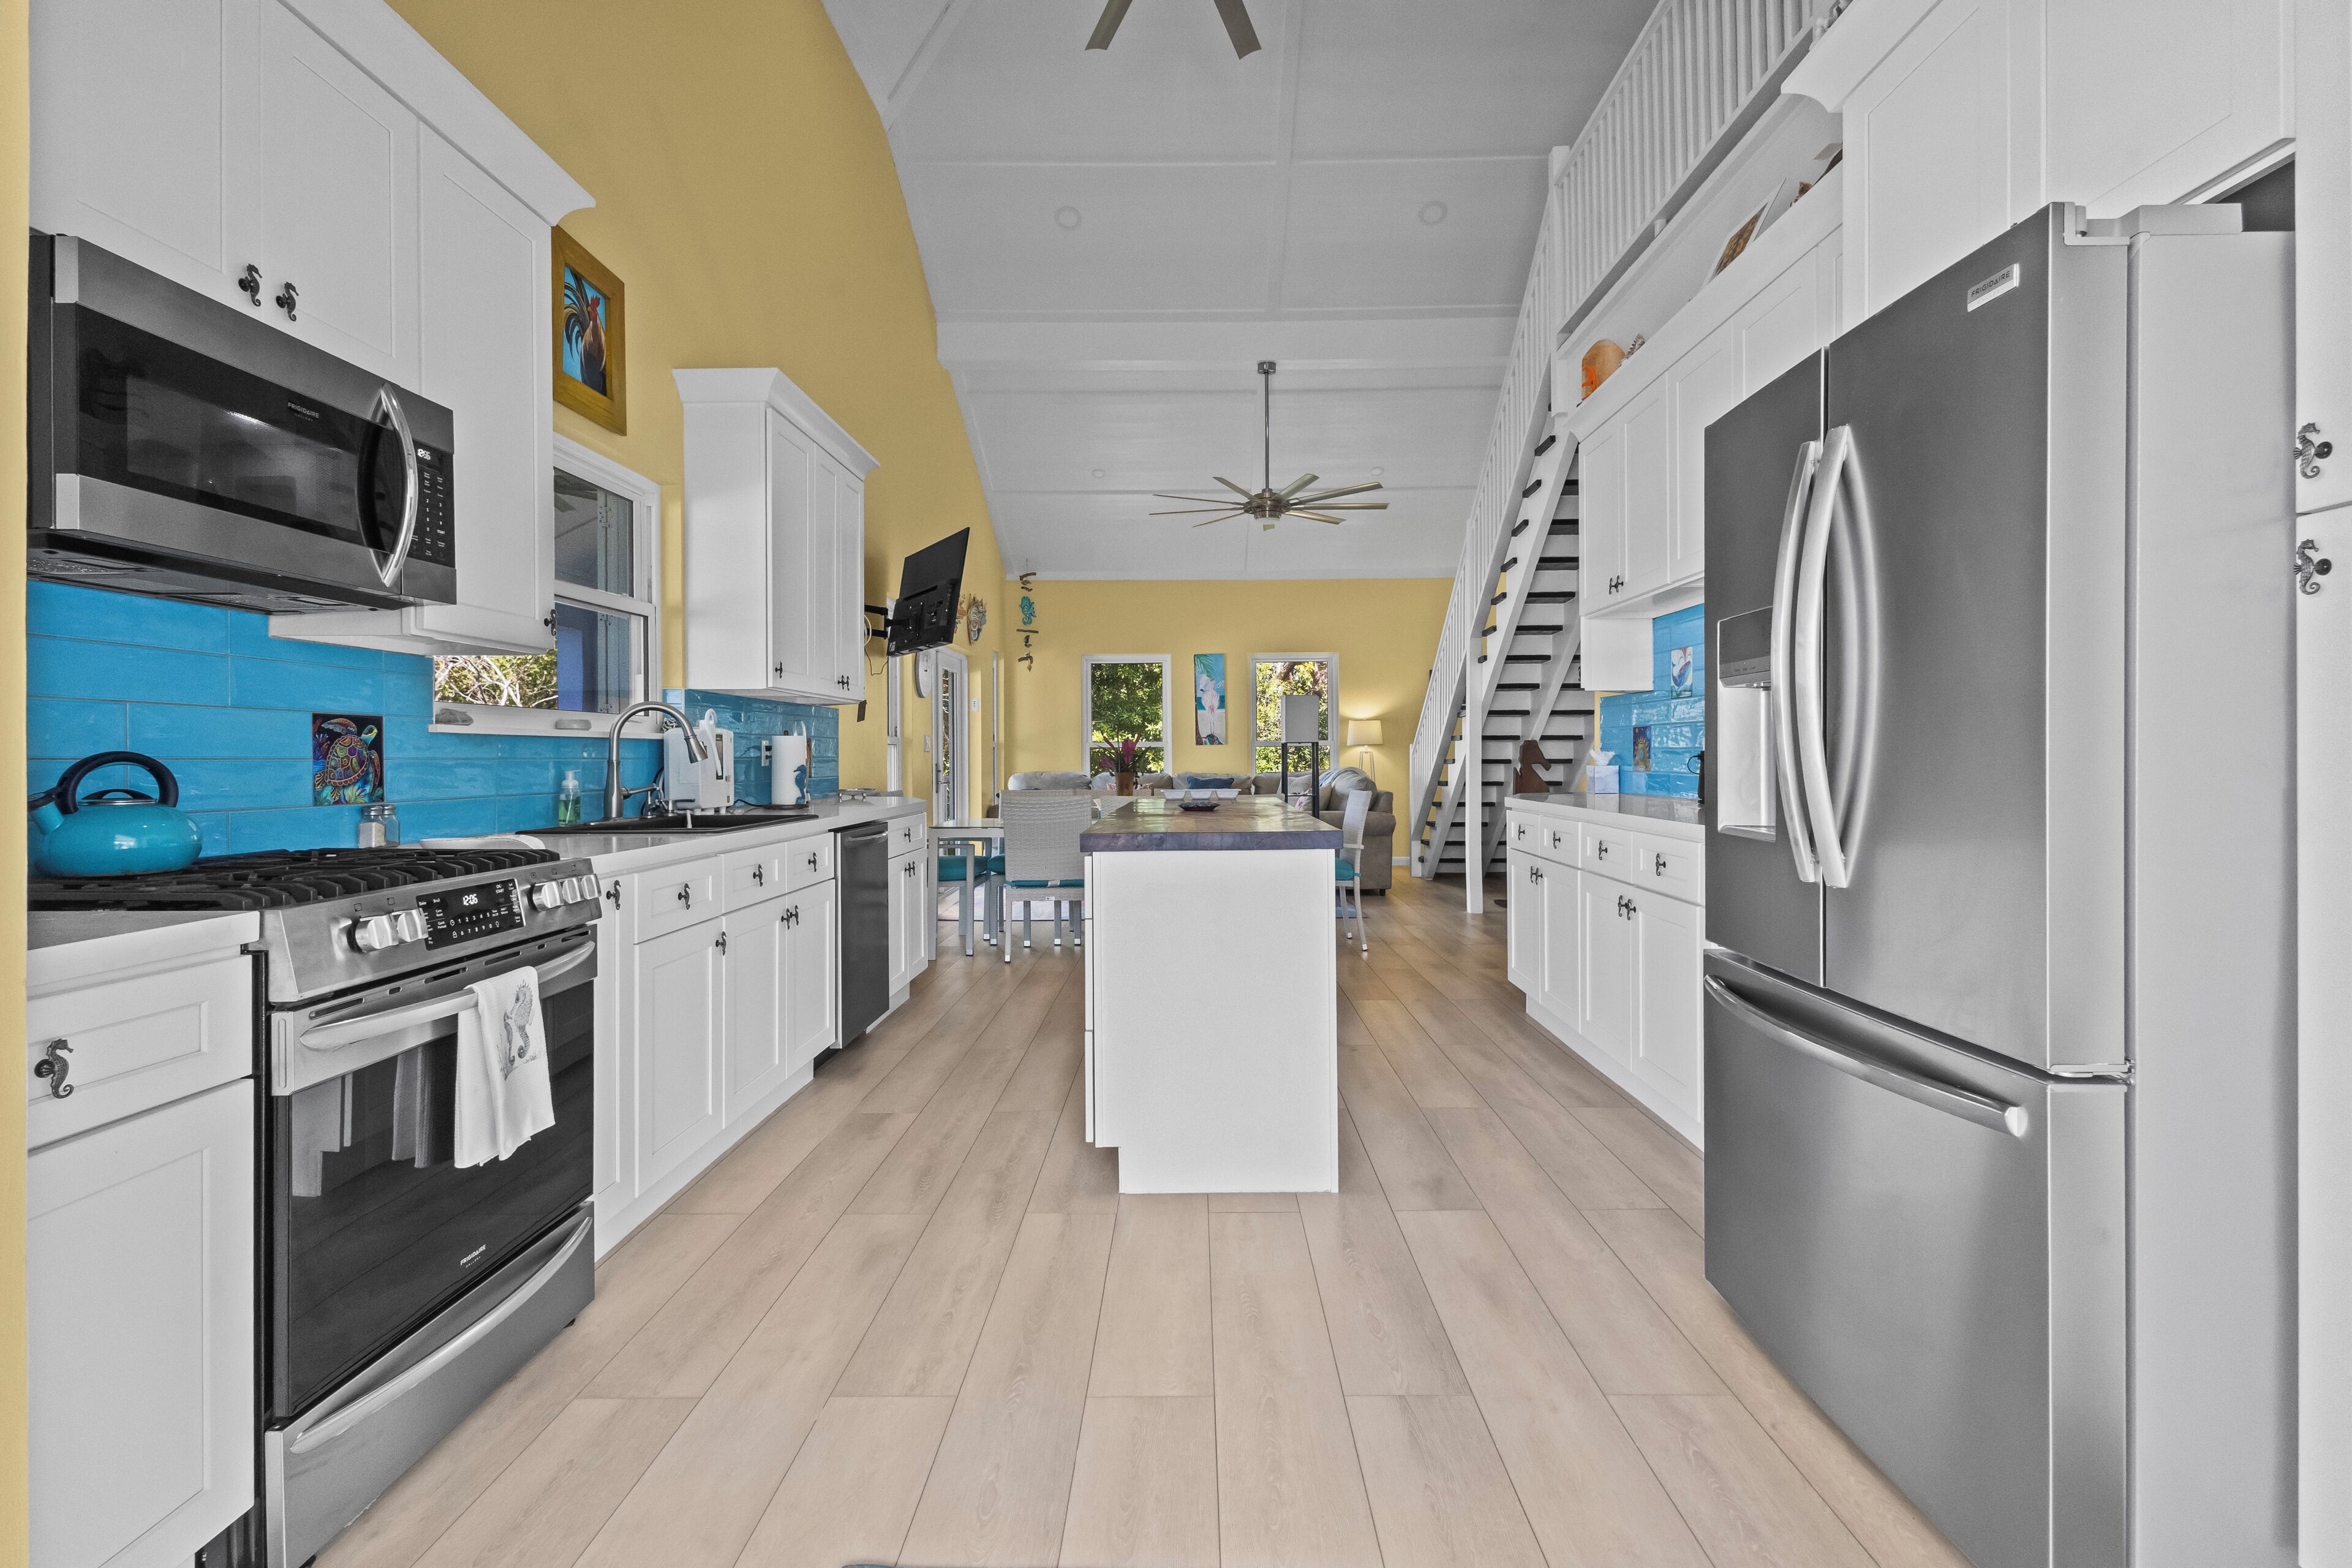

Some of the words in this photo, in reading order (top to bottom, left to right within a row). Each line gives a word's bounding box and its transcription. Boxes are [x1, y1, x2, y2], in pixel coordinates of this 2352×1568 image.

[1971, 270, 2011, 298] FRIGIDAIRE
[287, 402, 319, 418] FRIGIDAIRE
[462, 893, 478, 906] 12:06
[460, 1243, 486, 1266] FRIGIDAIRE
